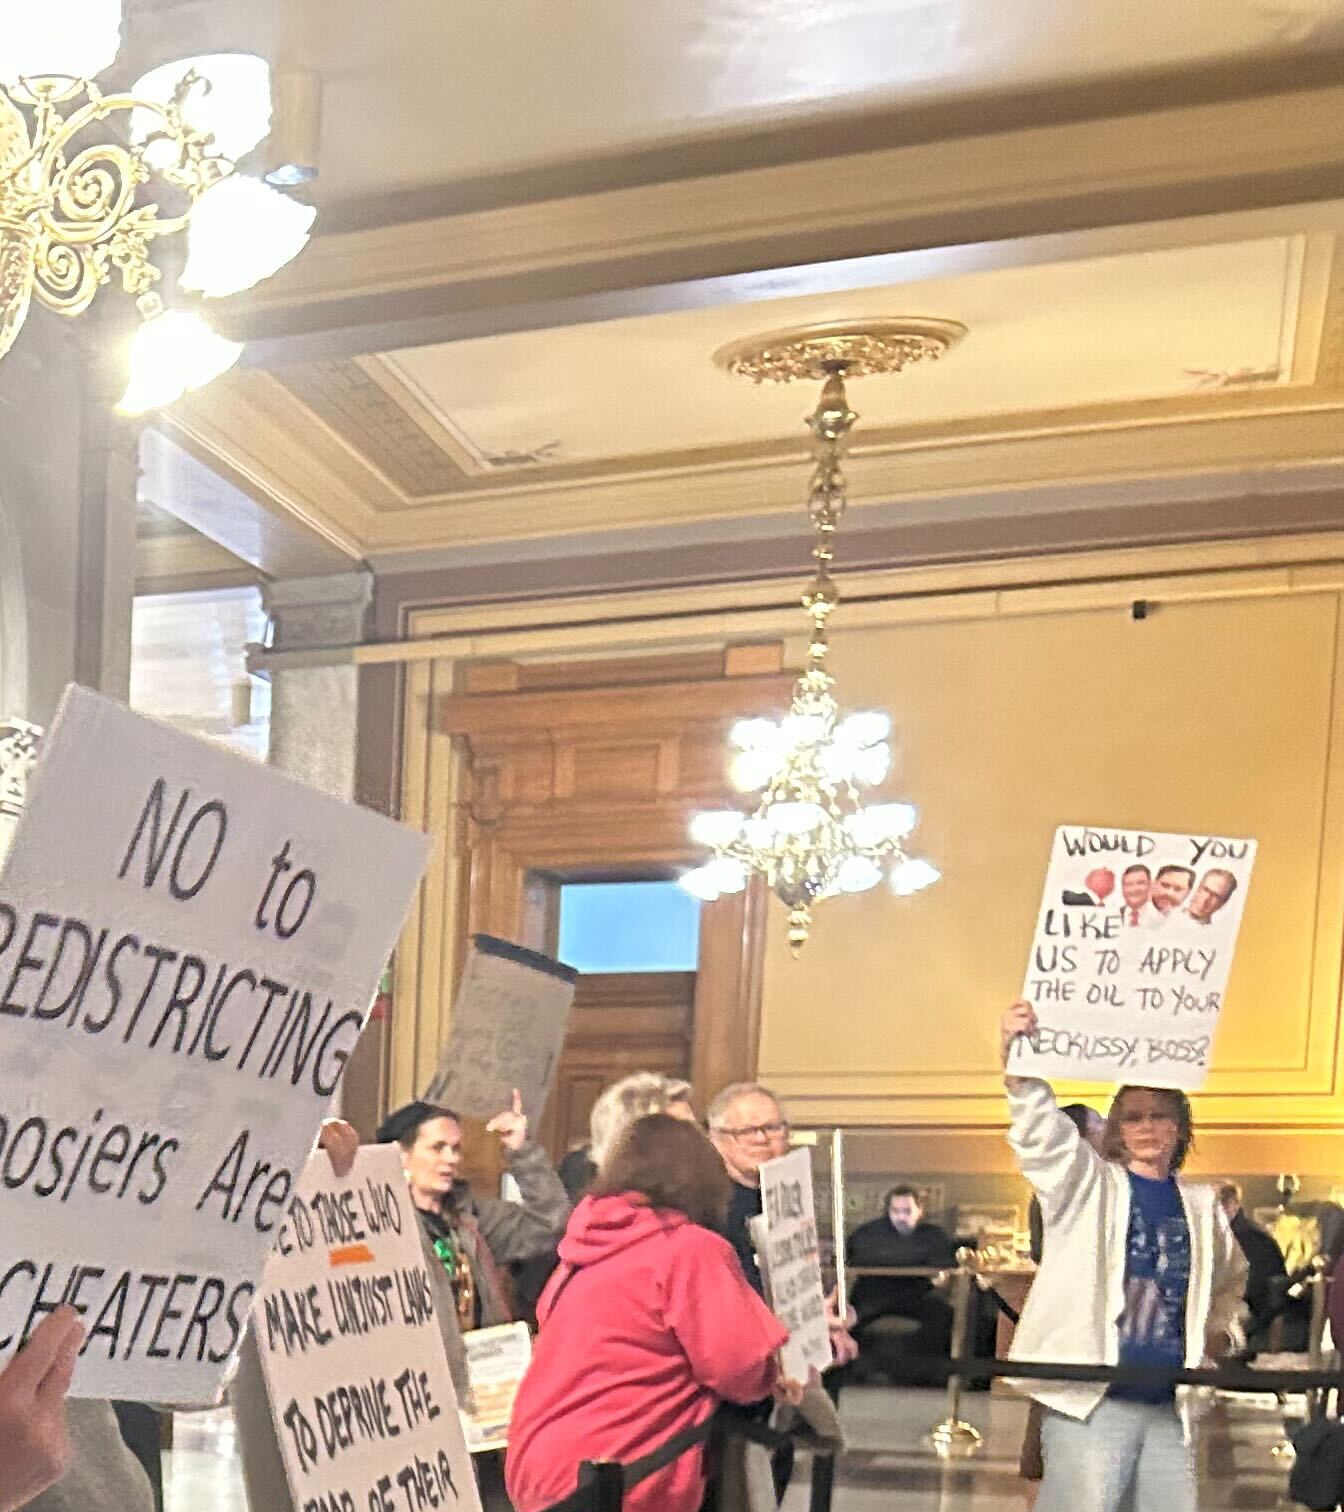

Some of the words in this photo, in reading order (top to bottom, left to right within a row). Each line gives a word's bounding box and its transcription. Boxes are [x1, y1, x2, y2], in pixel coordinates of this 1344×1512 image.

[119, 777, 227, 900] NO
[254, 840, 318, 939] to
[1063, 830, 1155, 857] WOULD
[1190, 837, 1248, 865] YOU
[1044, 907, 1122, 939] LIKE
[1031, 978, 1076, 1002] THE
[1086, 983, 1124, 1007] OIL
[1137, 987, 1164, 1010] TO
[1172, 985, 1220, 1015] YOUR
[1036, 945, 1077, 974] US
[1095, 949, 1120, 976] TO
[1139, 946, 1216, 981] APPLY
[197, 1129, 290, 1233] Are
[288, 1195, 313, 1252] TO
[311, 1190, 365, 1245] THOSE
[359, 1177, 401, 1235] WHO
[264, 1284, 332, 1355] MAKE
[327, 1274, 393, 1336] UNJUST
[394, 1266, 432, 1326] LAWS
[283, 1398, 318, 1474] TO
[314, 1377, 400, 1460] DEPRIVE
[394, 1368, 440, 1429] THE
